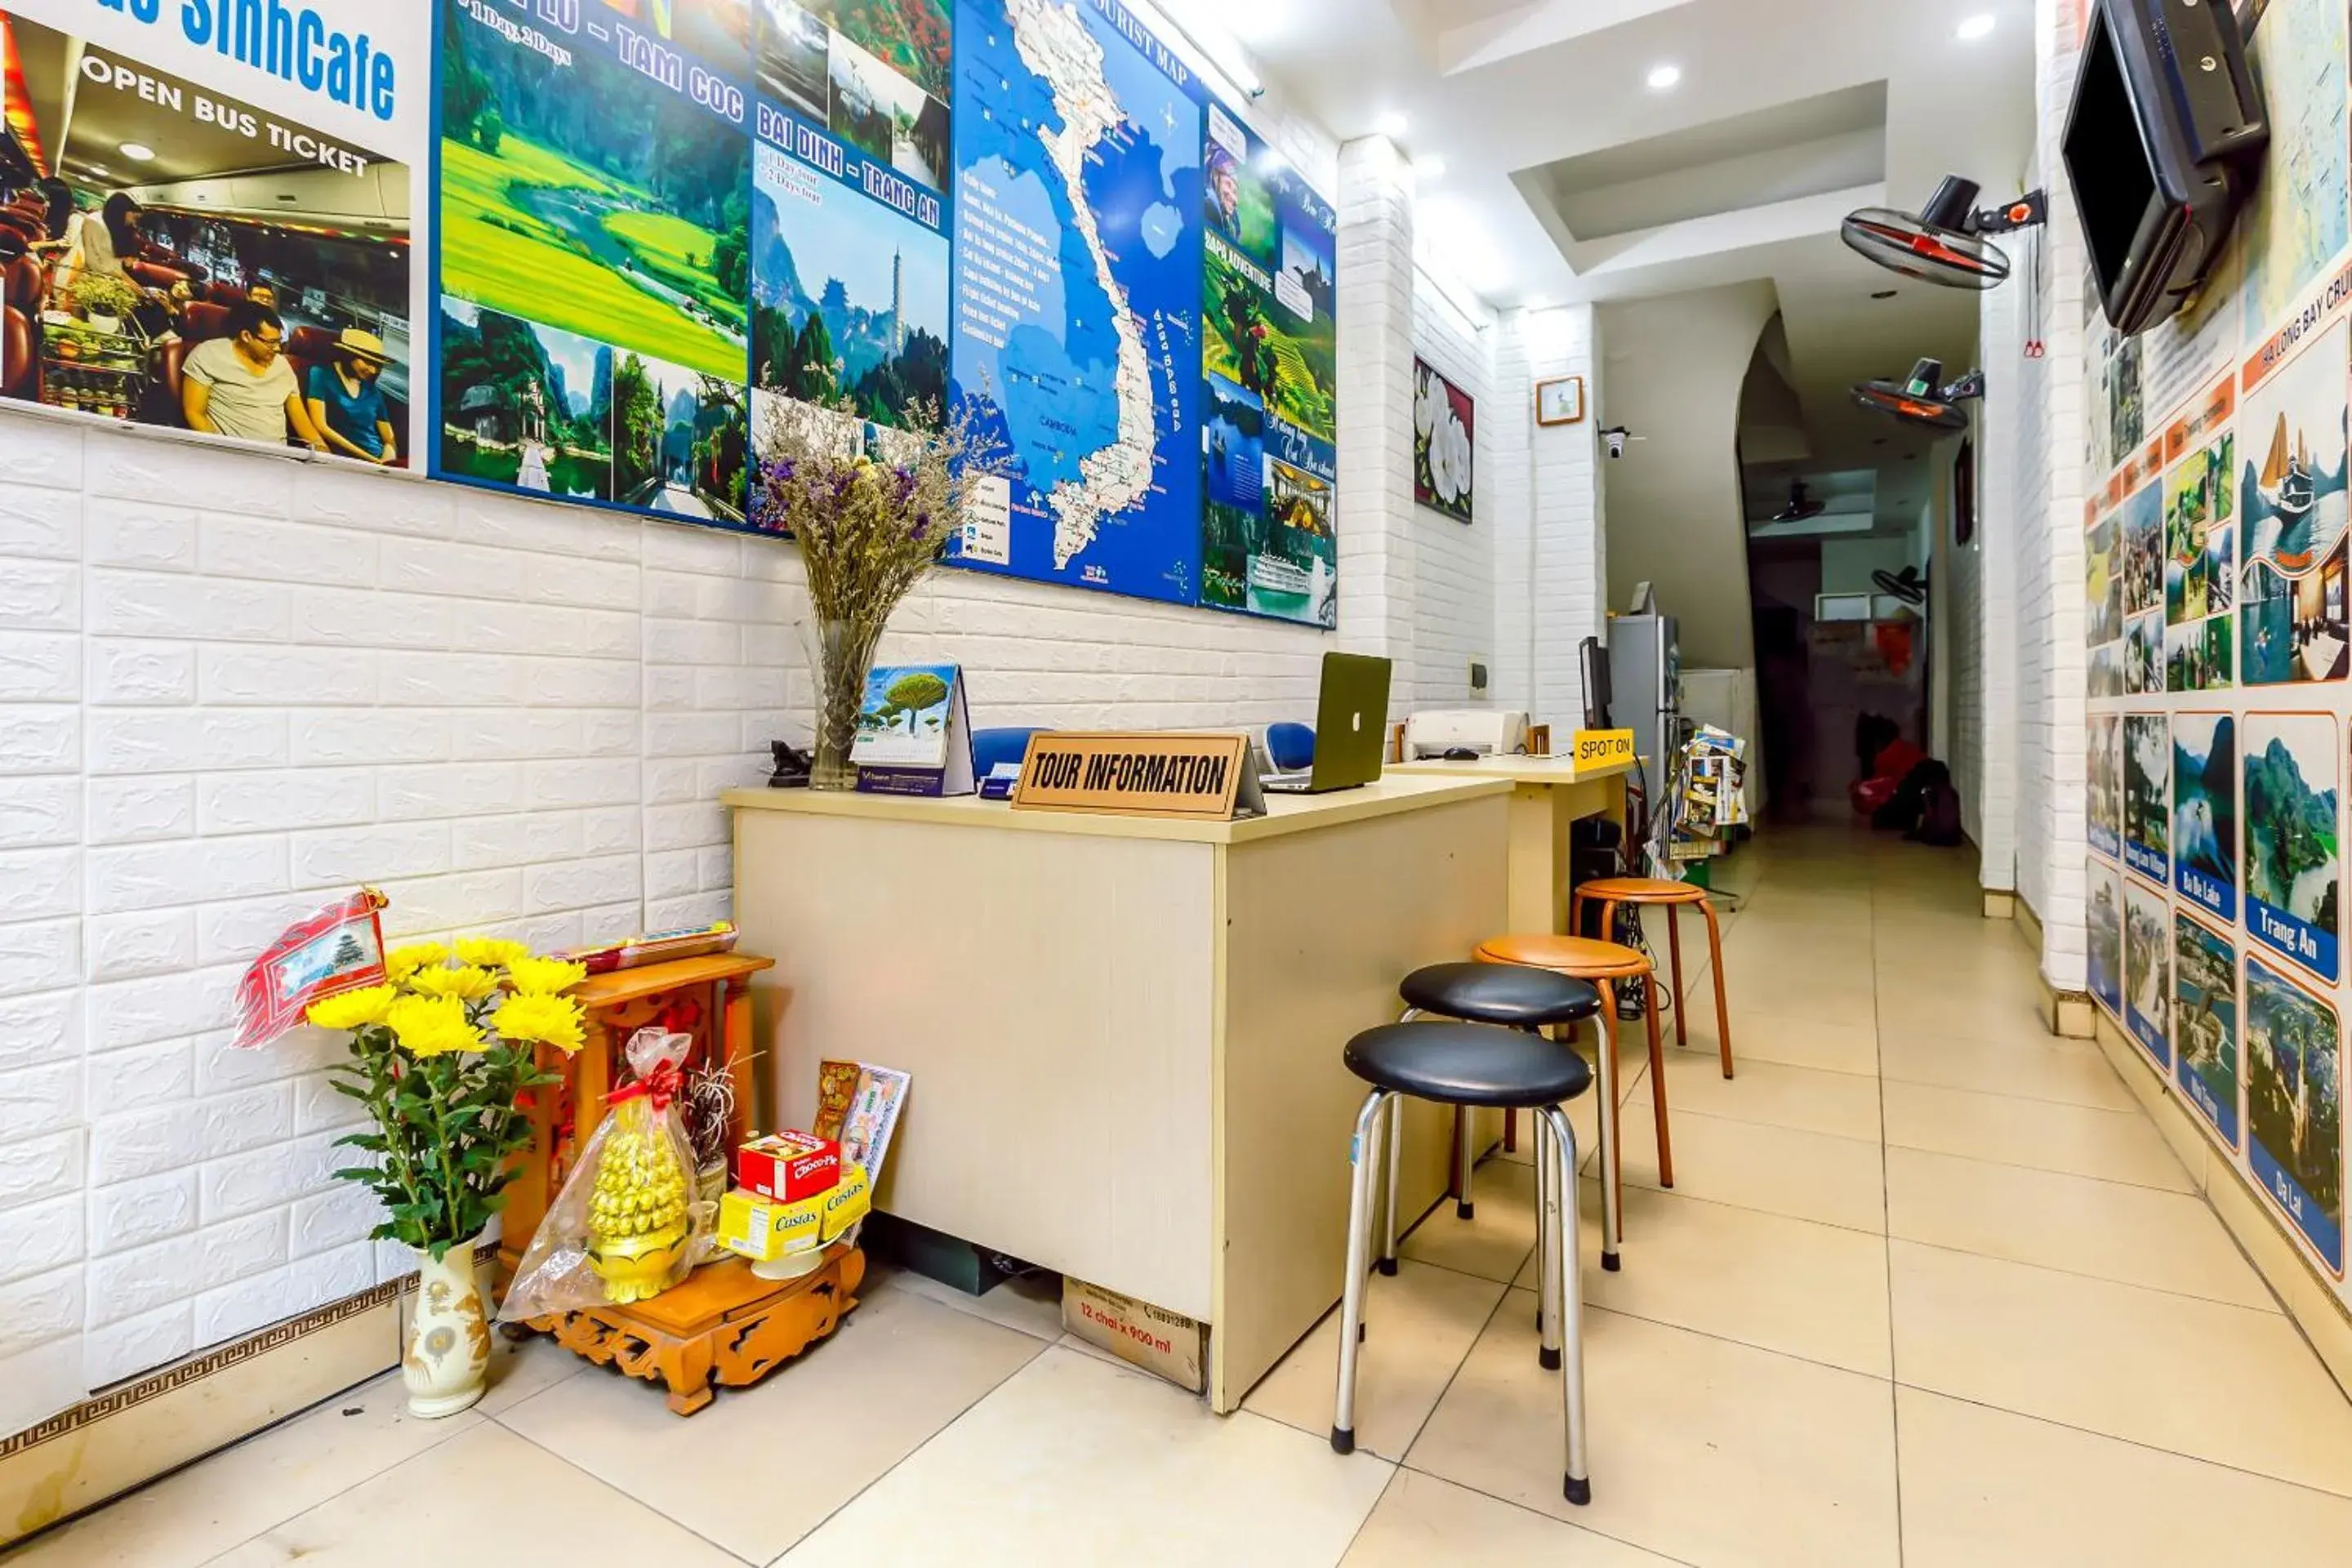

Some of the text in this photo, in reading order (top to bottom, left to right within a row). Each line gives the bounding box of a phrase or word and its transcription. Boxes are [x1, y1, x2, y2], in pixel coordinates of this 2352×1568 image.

[616, 22, 683, 93] TAM
[689, 69, 745, 123] COC
[1156, 43, 1187, 86] MAP
[81, 56, 368, 177] OPEN BUS TICKET
[756, 101, 793, 152] BAI
[797, 122, 844, 178] DINH
[862, 158, 915, 216] TRANG
[916, 191, 940, 229] AN
[2276, 317, 2301, 358] LONG
[2303, 294, 2323, 333] BAY
[1031, 751, 1228, 795] TOUR INFORMATION
[1580, 737, 1630, 760] SPOT ON
[2260, 906, 2317, 960] Trang An
[775, 1210, 817, 1232] Custas
[826, 1184, 864, 1211] Custas
[1080, 1302, 1092, 1318] 12
[1095, 1309, 1118, 1330] chai
[1129, 1325, 1153, 1347] 900
[1155, 1339, 1171, 1355] ml
